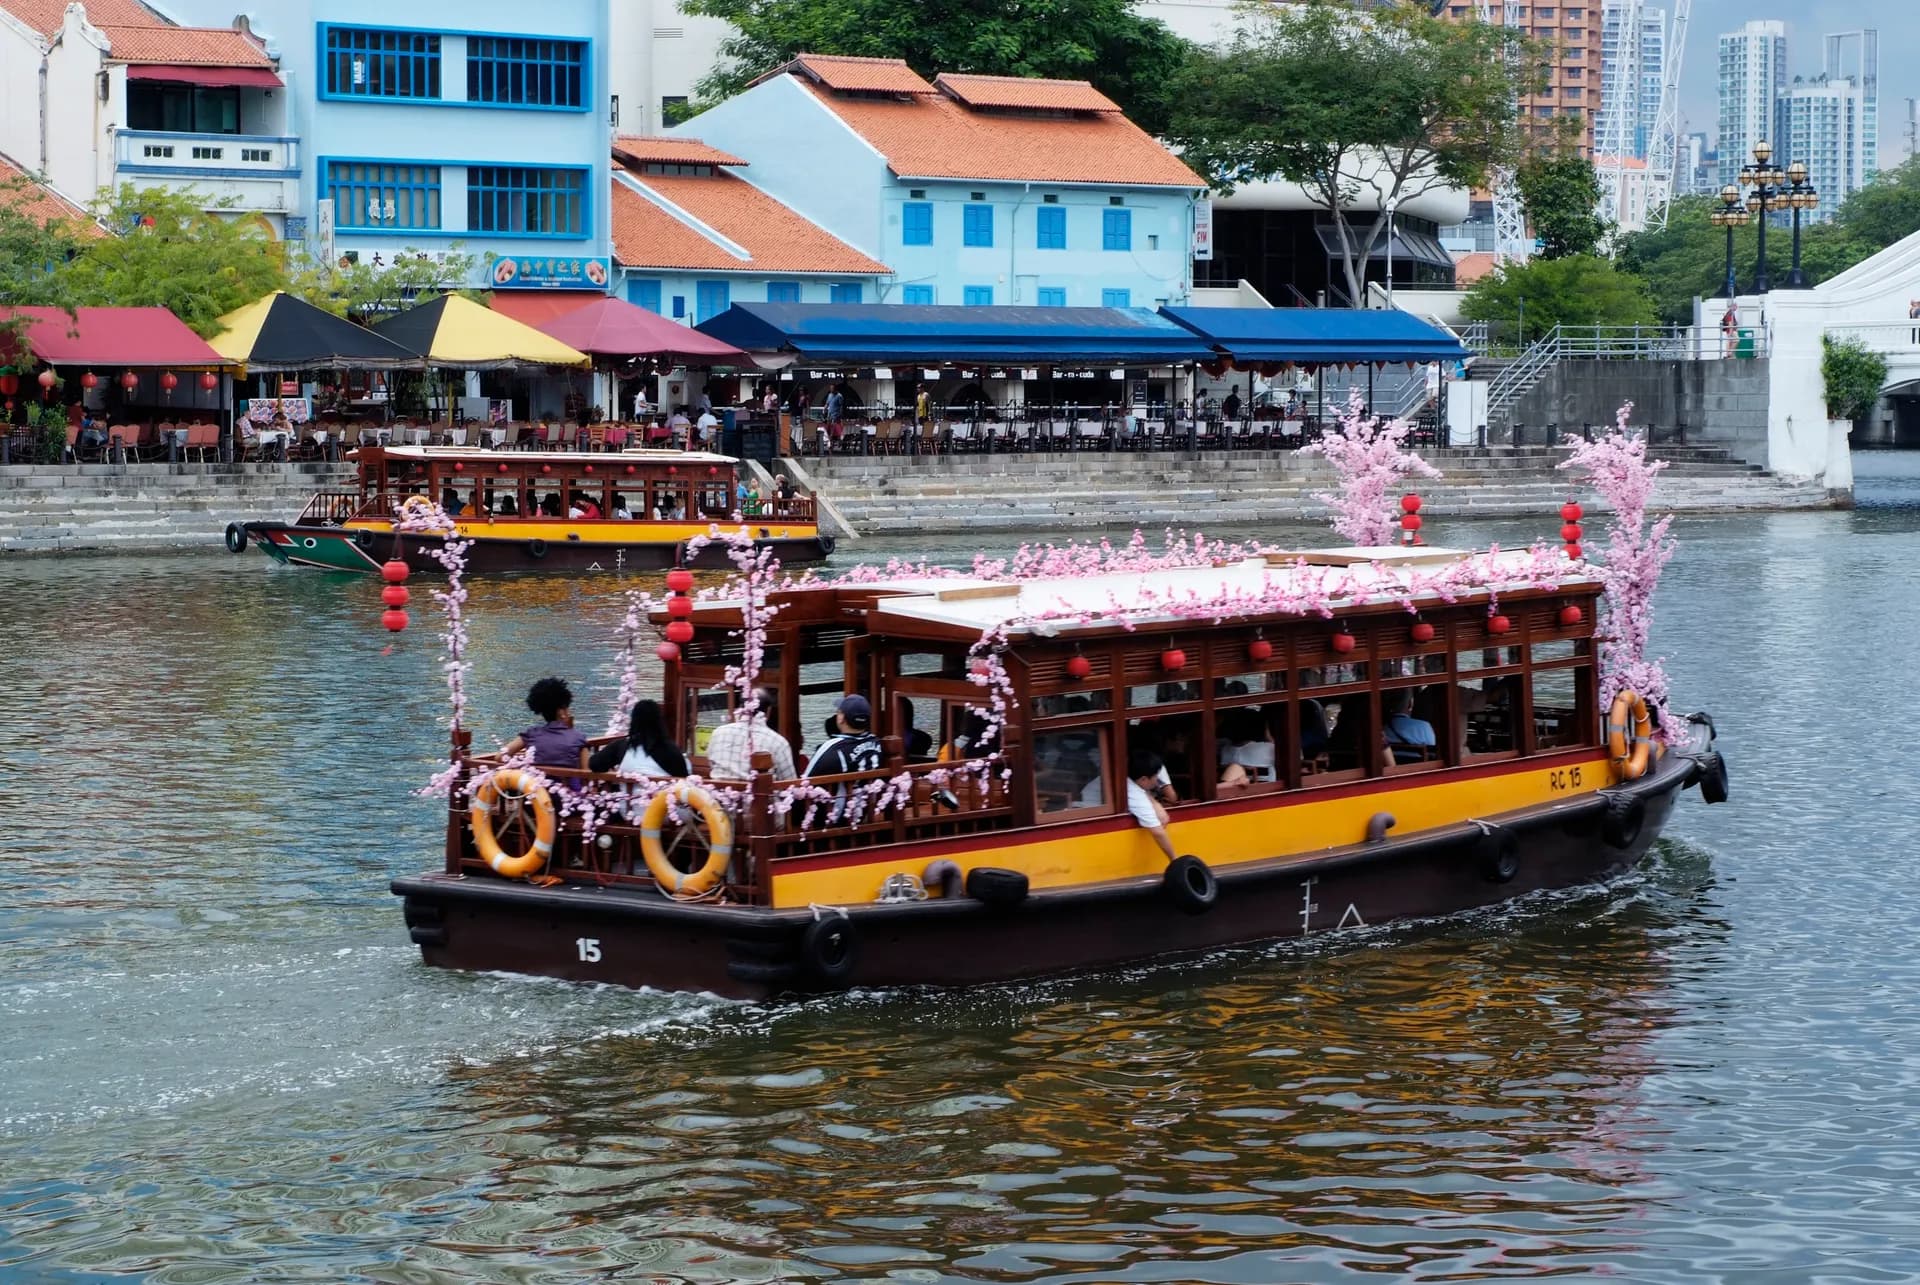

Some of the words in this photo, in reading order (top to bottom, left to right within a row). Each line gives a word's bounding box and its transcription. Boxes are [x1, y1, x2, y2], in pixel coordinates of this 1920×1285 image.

[461, 526, 468, 534] 14
[858, 754, 879, 771] 11
[1551, 771, 1566, 792] RC
[1569, 767, 1581, 788] 15
[575, 937, 602, 963] 15
